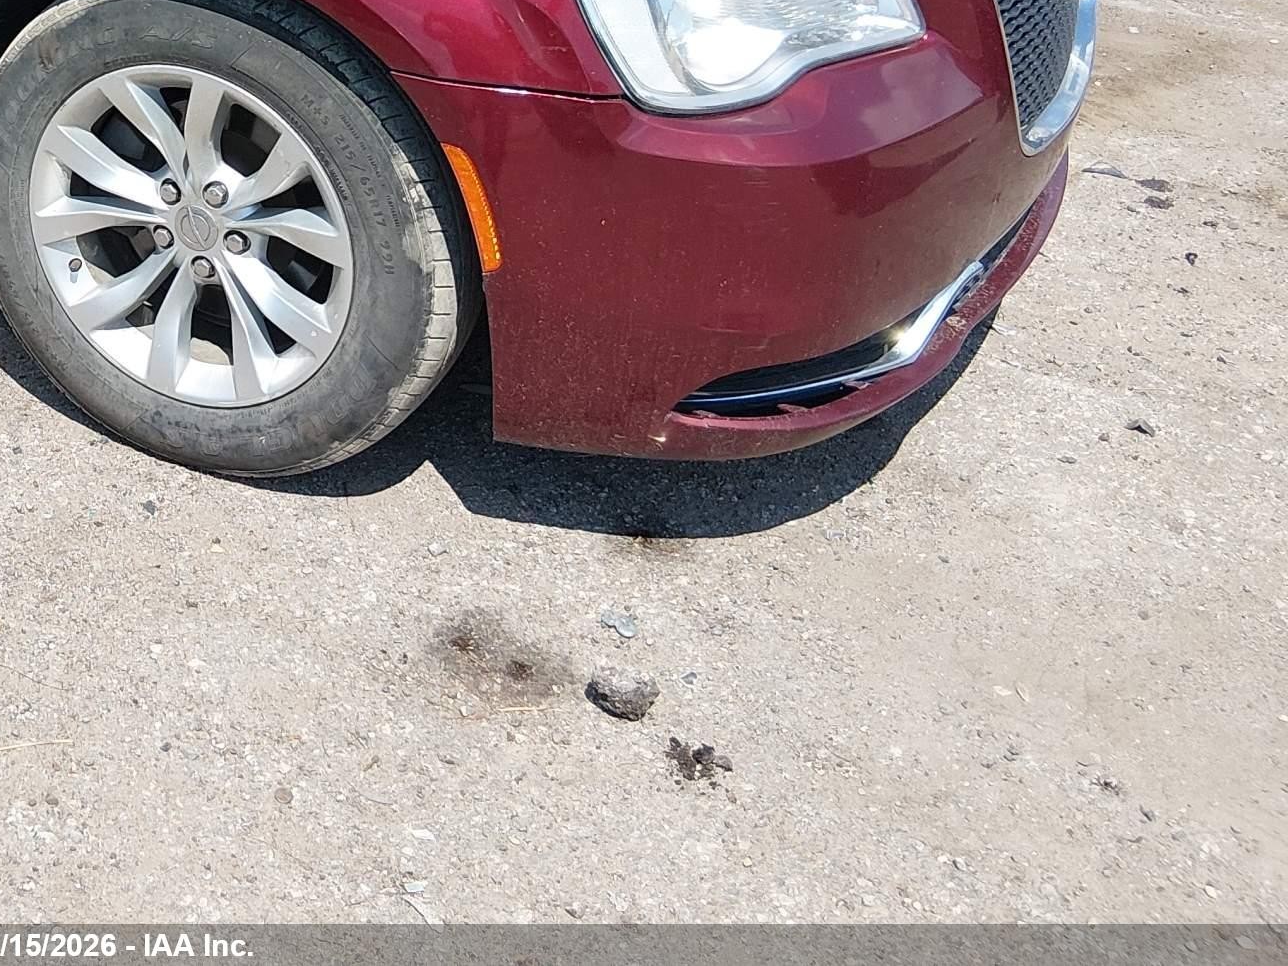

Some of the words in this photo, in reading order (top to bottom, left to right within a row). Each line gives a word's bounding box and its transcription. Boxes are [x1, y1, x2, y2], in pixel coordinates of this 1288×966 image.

[138, 24, 218, 51] A/S
[300, 94, 330, 126] M+S
[333, 132, 387, 228] 215/65R17
[379, 240, 395, 276] 99H
